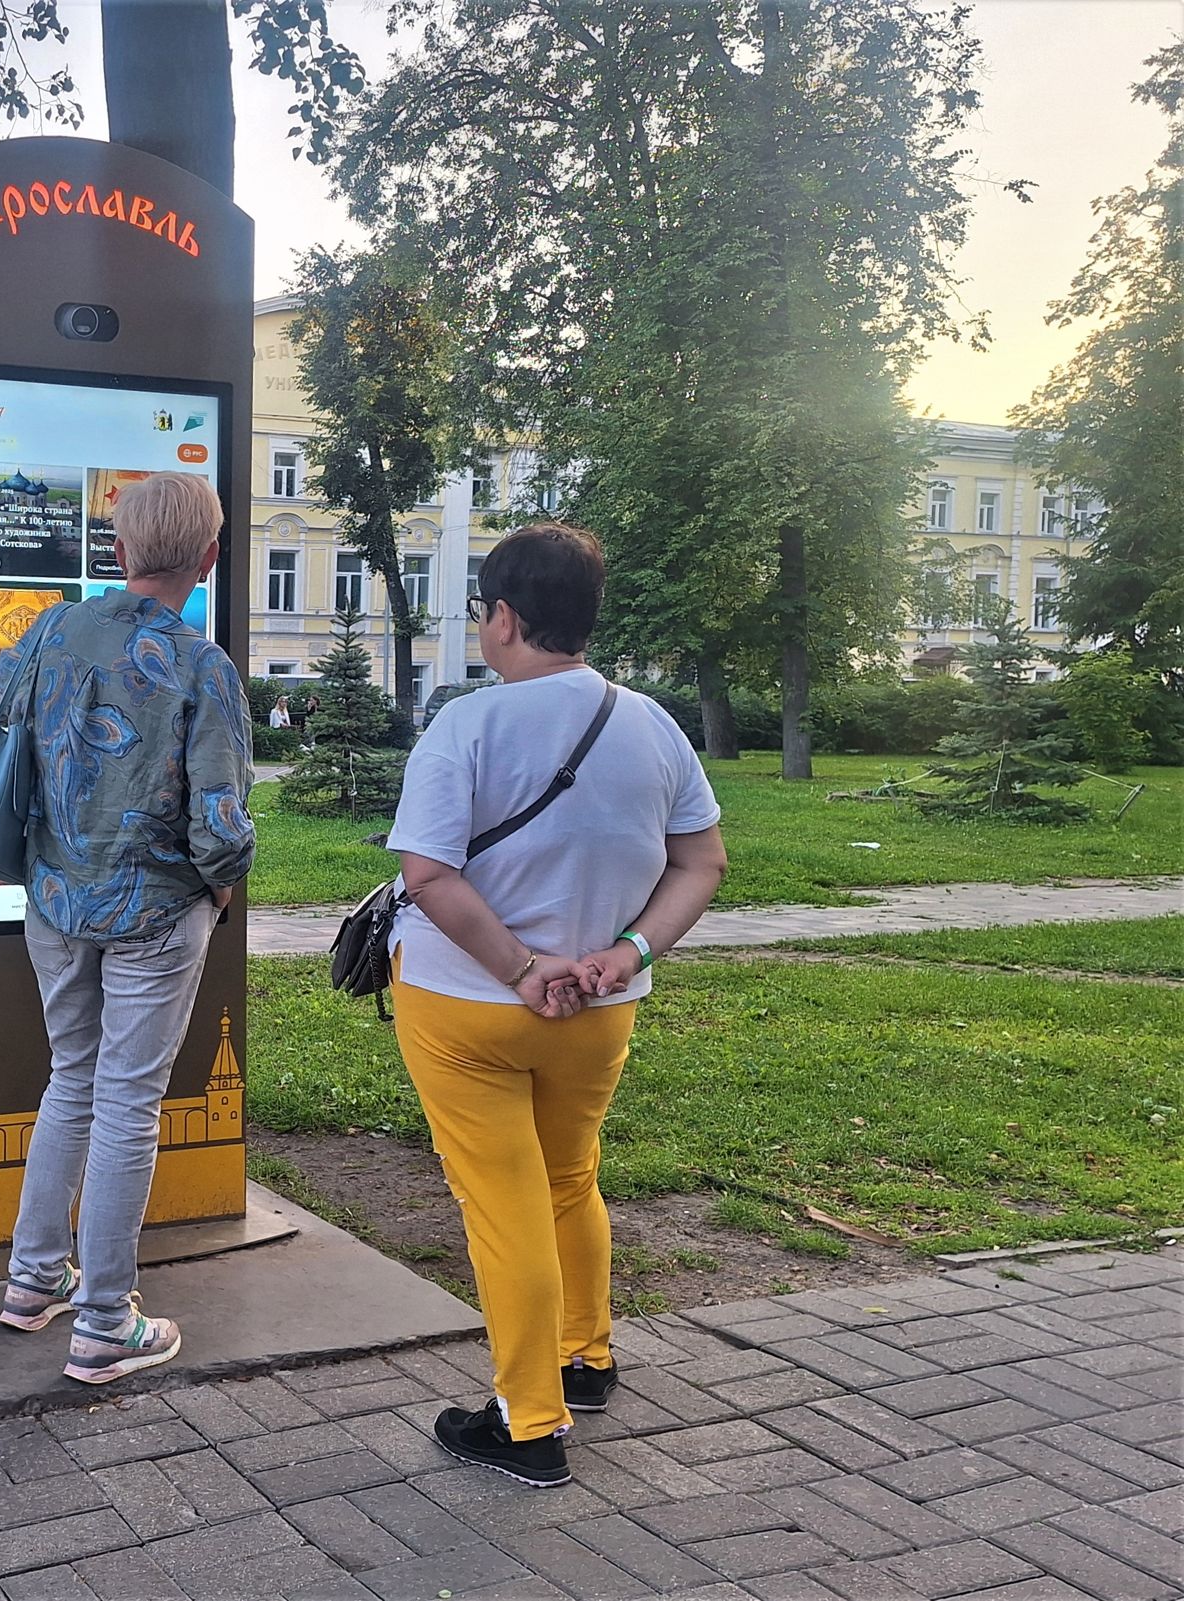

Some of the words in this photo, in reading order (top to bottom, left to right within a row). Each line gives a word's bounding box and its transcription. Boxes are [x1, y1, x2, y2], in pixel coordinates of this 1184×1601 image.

[44, 506, 73, 516] страна
[20, 516, 27, 525] К
[29, 516, 73, 527] 100-летию
[4, 529, 51, 538] художника
[0, 538, 43, 549] Сотскова»
[89, 543, 115, 552] Выста
